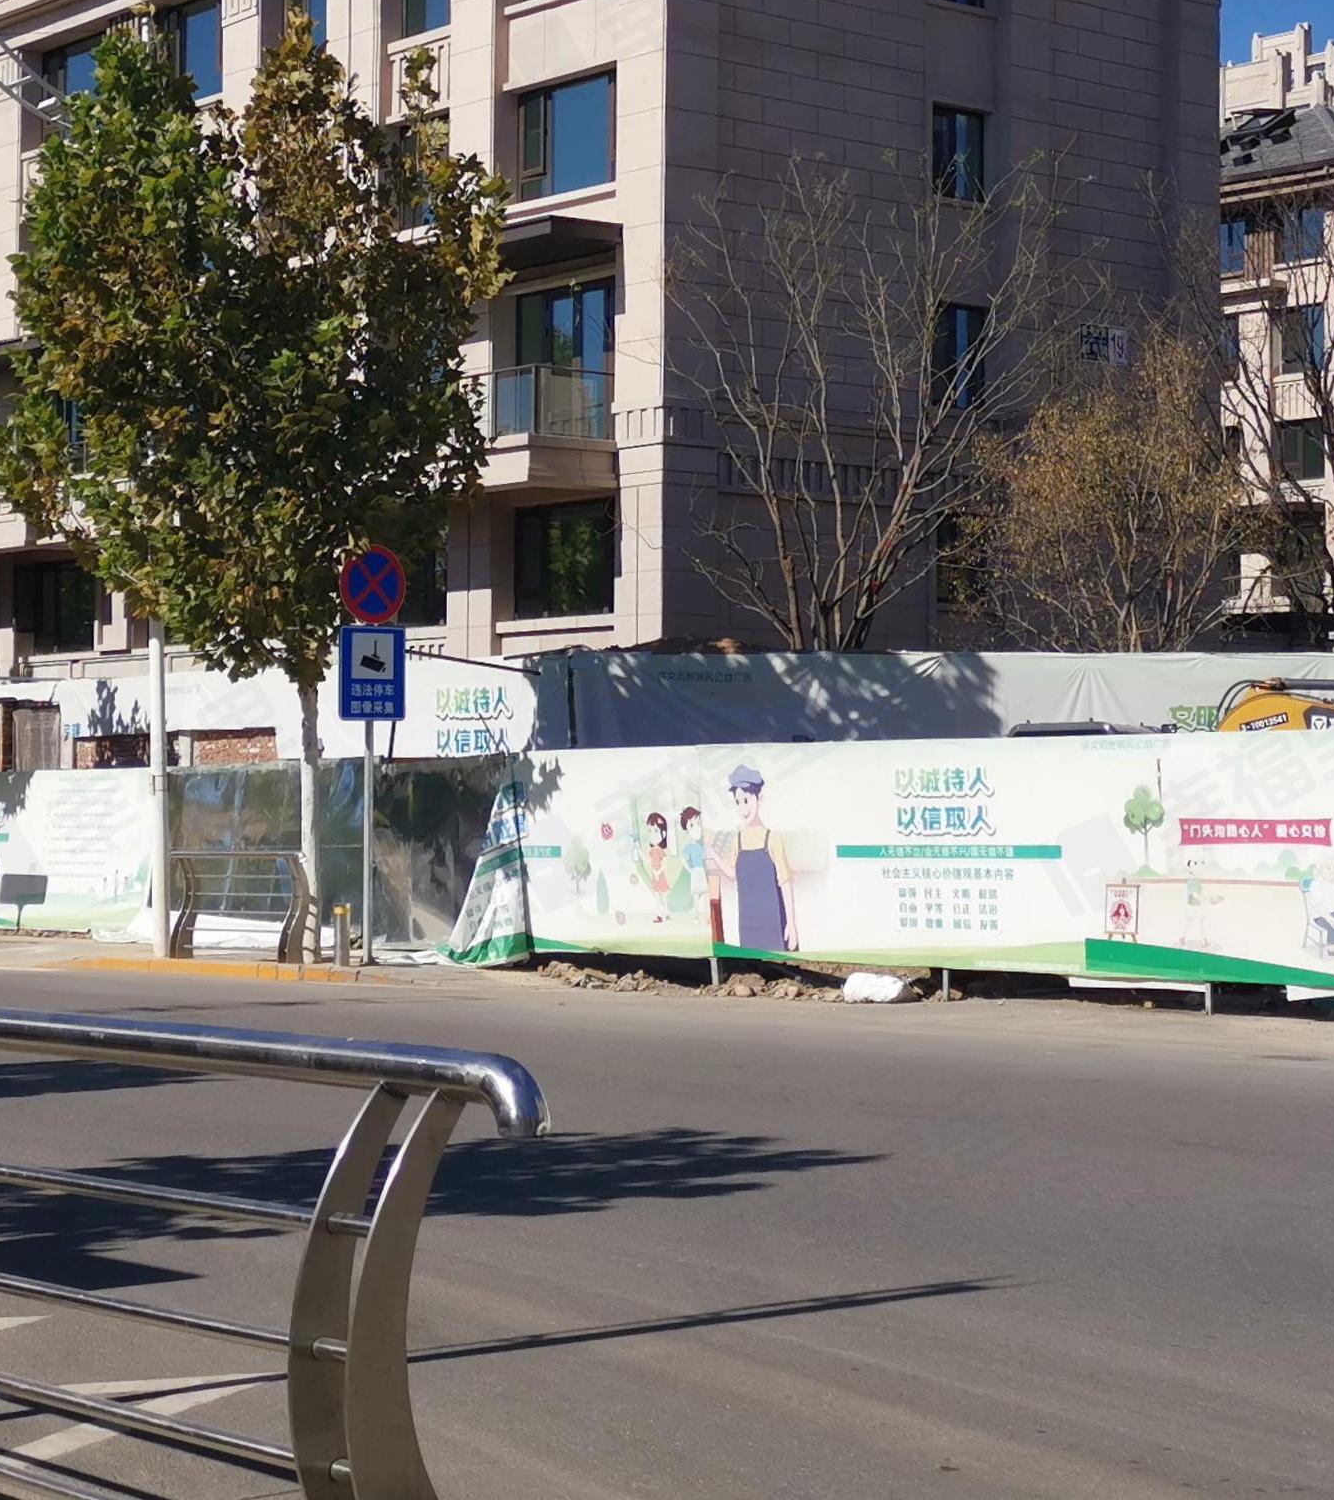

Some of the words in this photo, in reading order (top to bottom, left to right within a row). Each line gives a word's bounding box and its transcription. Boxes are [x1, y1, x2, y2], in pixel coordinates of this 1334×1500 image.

[350, 683, 395, 697] 违法停车
[436, 686, 511, 717] 以诚待人
[436, 728, 512, 754] 以信取人
[894, 766, 992, 795] 以诚待人
[896, 805, 993, 832] 以信取人
[881, 867, 1015, 882] 社会主义核心价值观基本内容
